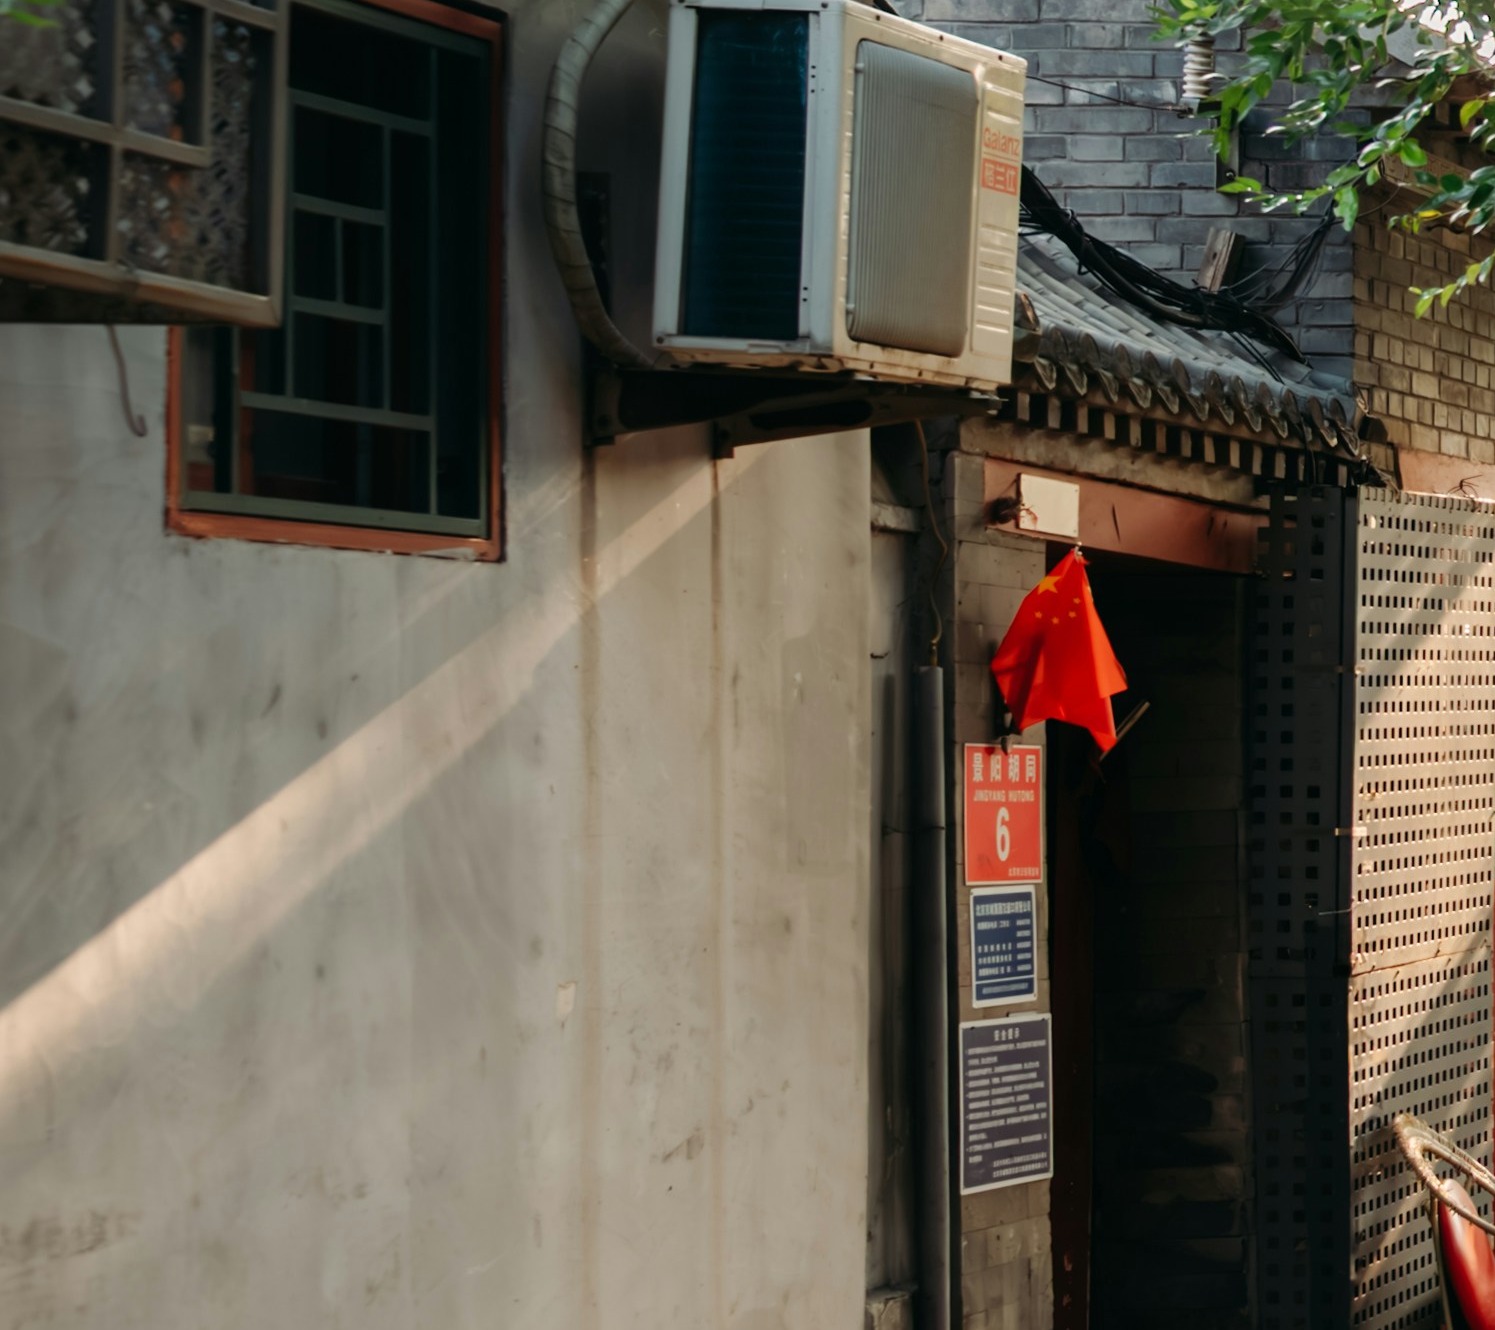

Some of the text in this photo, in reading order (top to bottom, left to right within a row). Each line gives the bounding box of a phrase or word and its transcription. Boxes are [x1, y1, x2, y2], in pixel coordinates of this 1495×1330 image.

[984, 127, 1020, 156] Galanz
[984, 162, 1017, 192] 格兰仕
[972, 752, 1036, 783] 景阳胡同
[974, 789, 1035, 802] JINGYANG HUTONG
[996, 806, 1010, 861] 6
